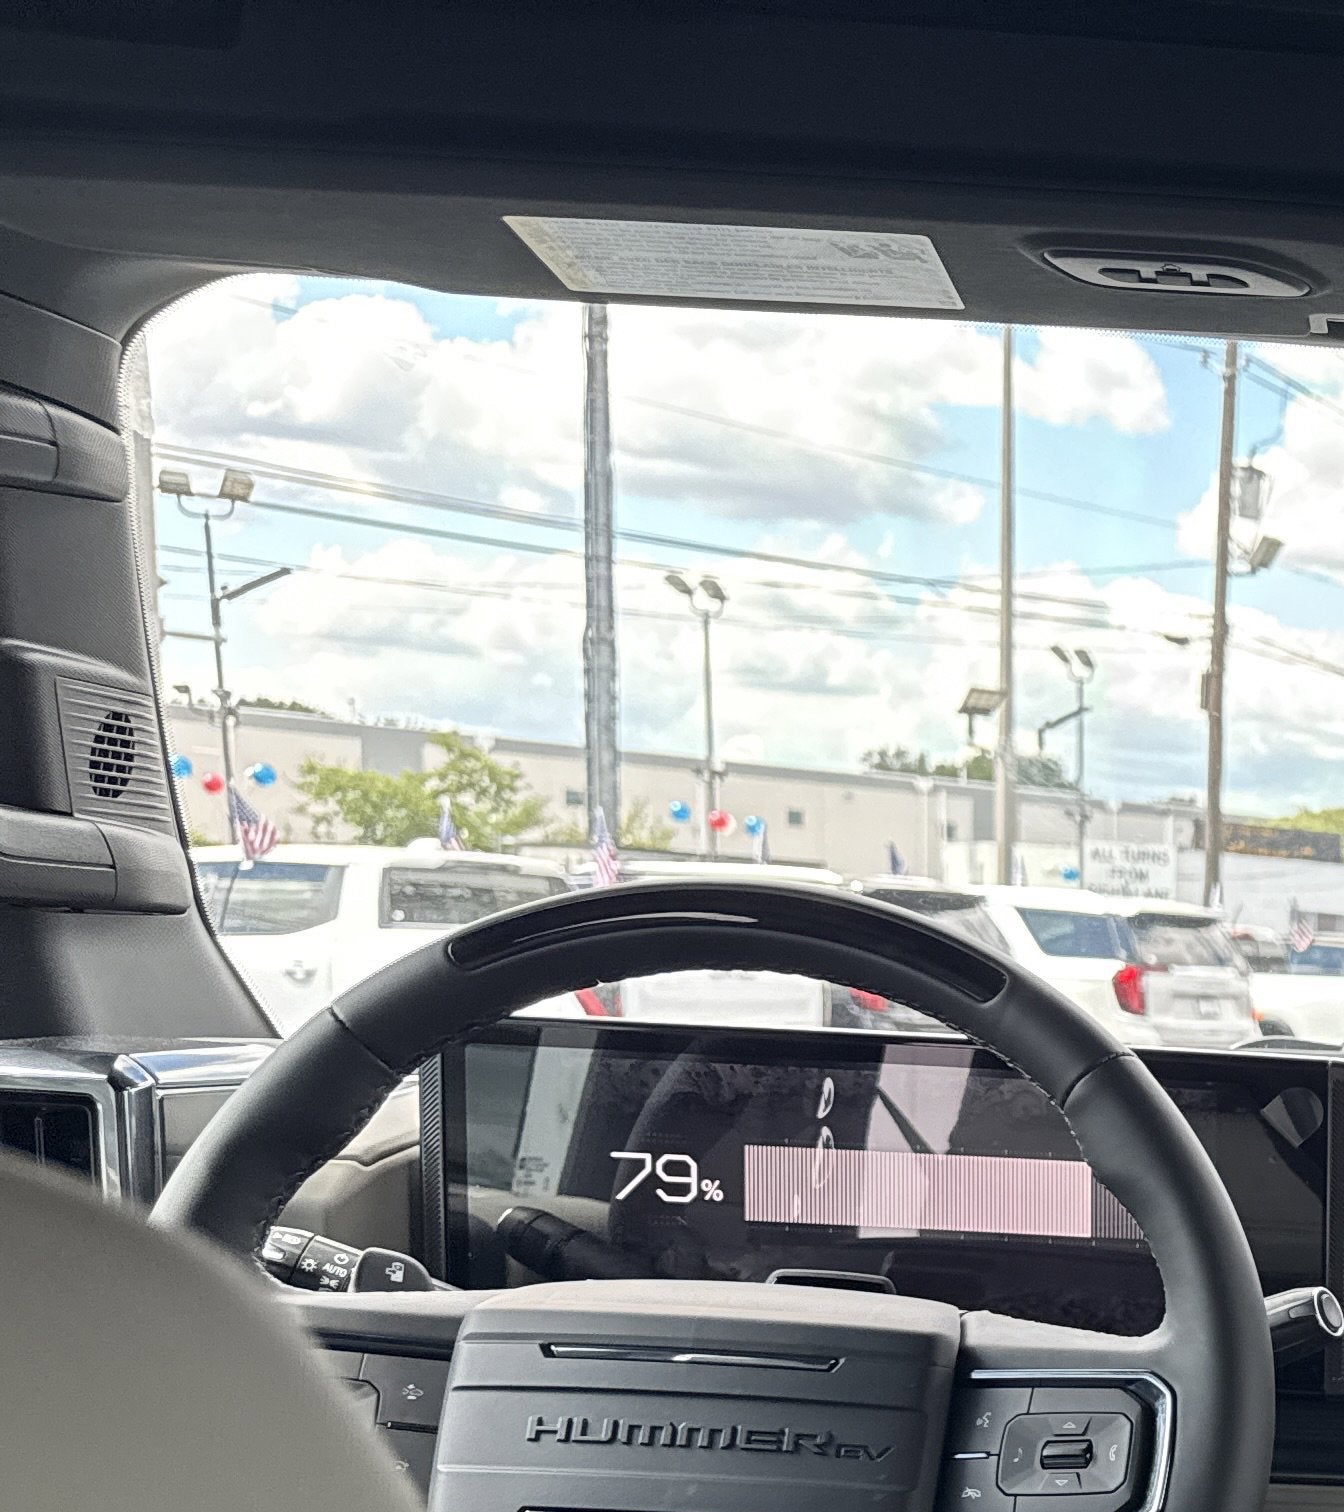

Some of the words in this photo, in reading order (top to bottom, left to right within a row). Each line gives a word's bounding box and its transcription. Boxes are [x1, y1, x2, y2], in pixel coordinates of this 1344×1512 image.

[322, 1262, 348, 1278] AUTO
[526, 1415, 833, 1457] HUMMER
[834, 1443, 897, 1463] EV
